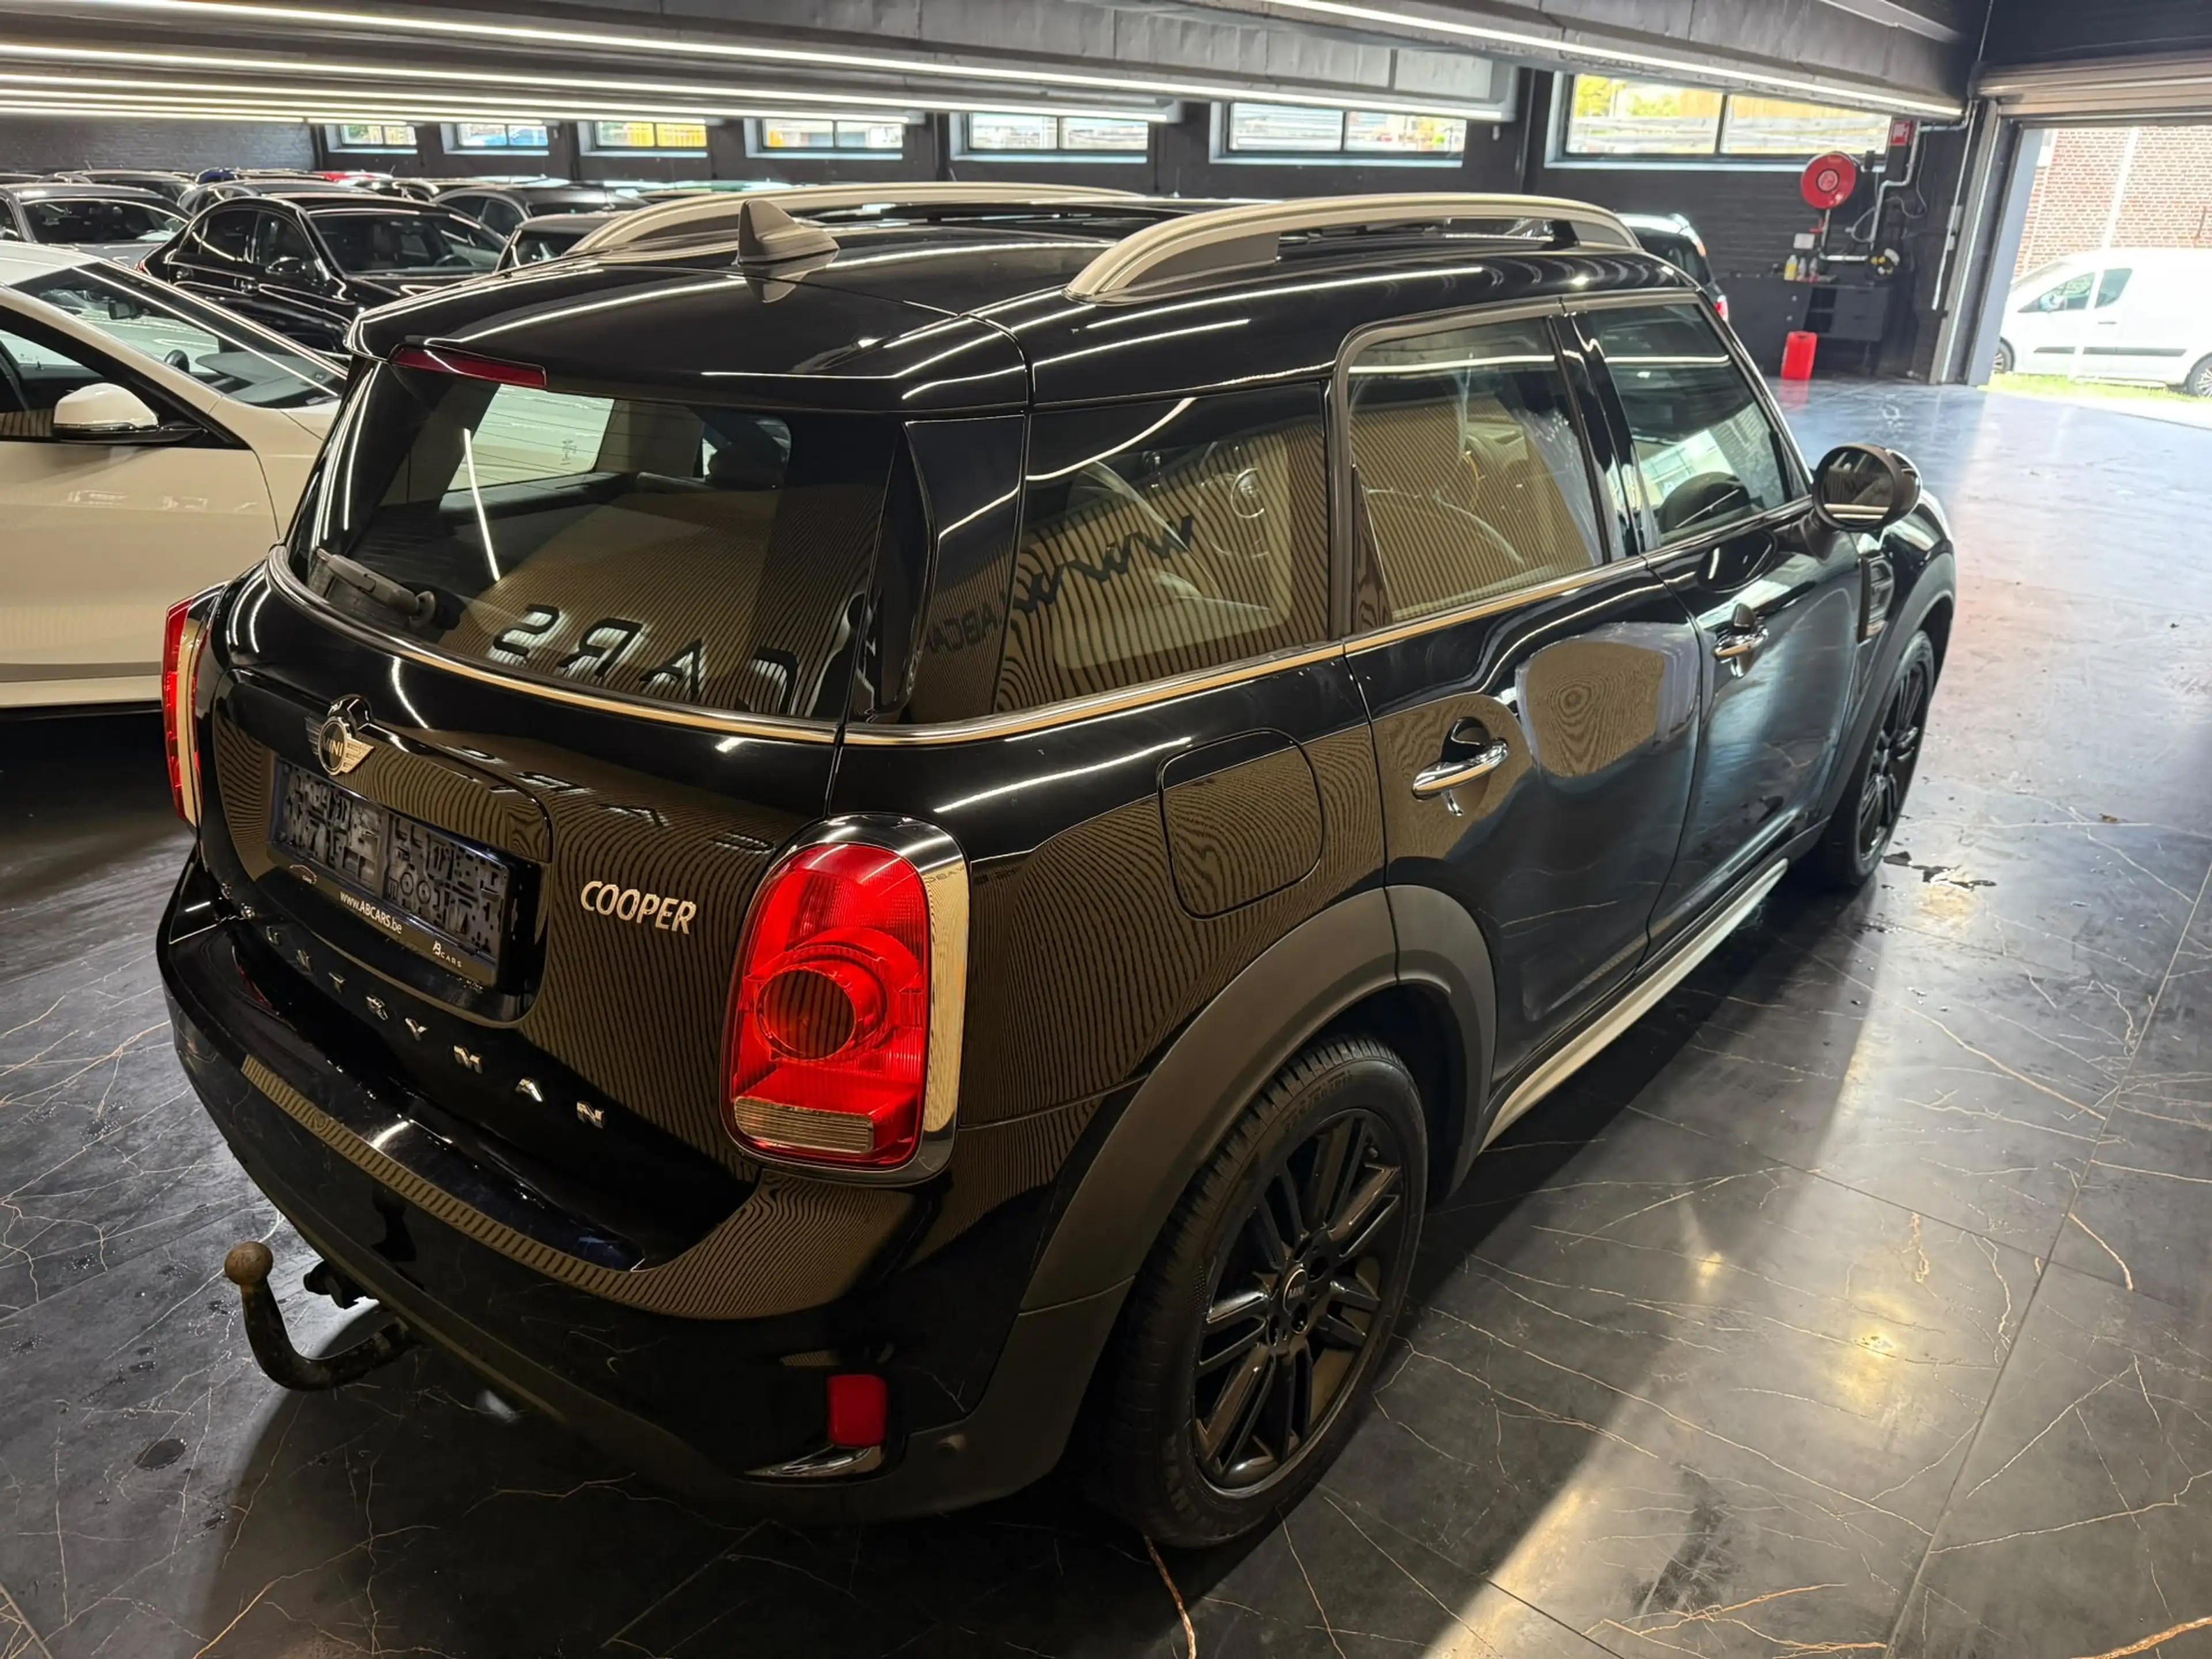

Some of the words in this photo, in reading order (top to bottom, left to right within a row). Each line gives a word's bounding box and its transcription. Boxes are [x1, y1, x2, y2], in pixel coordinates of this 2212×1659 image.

[324, 734, 344, 757] MINI
[340, 891, 402, 934] www.ABCARS.be
[581, 880, 696, 934] COOPER
